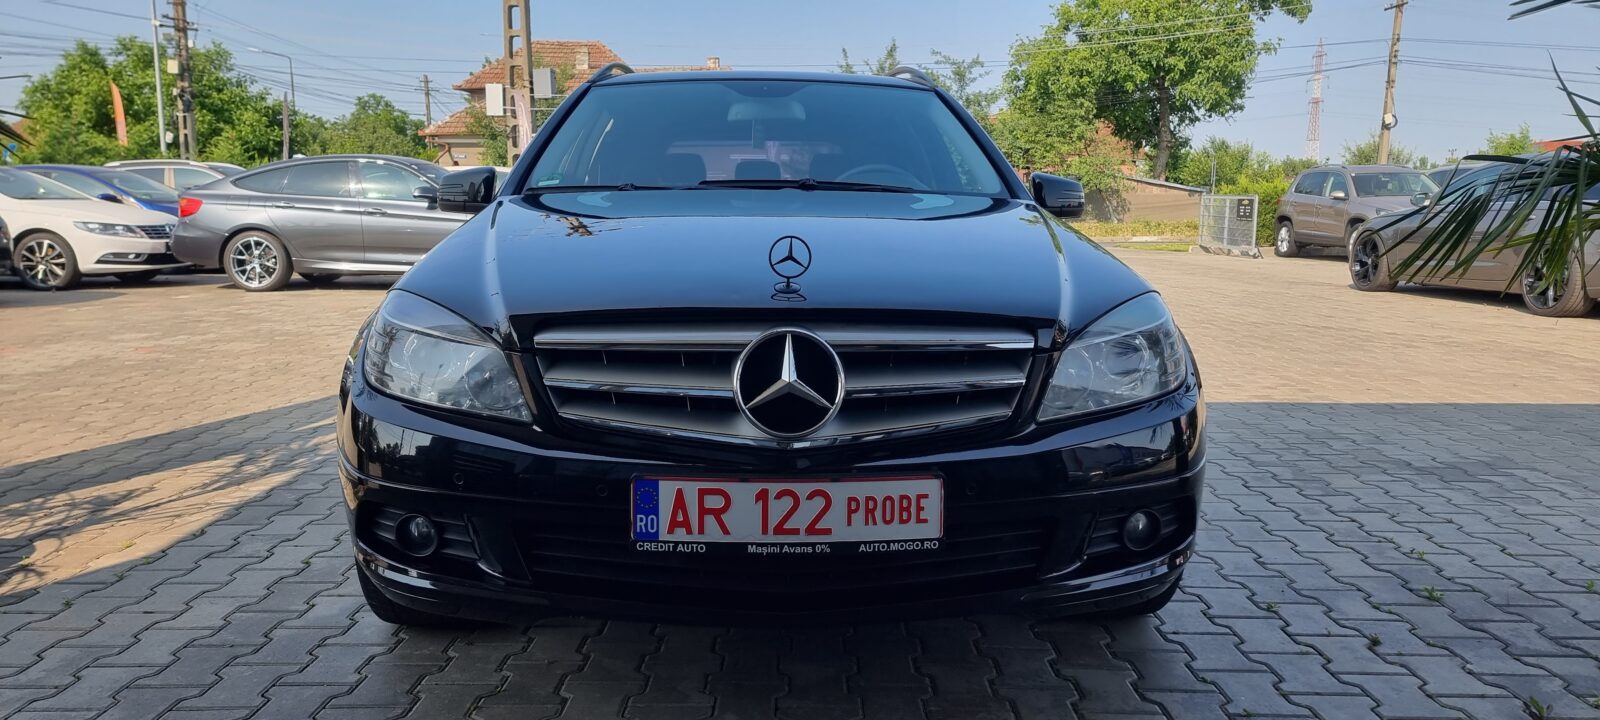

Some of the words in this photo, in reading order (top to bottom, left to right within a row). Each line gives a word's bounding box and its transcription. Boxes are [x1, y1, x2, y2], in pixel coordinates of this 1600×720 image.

[666, 486, 732, 536] AR
[753, 487, 833, 537] 122
[846, 493, 930, 528] PROBE
[636, 514, 657, 533] RO
[636, 542, 675, 552] CREDIT
[677, 543, 706, 553] AUTO
[782, 544, 813, 553] Avans
[815, 544, 831, 553] 0%
[859, 541, 939, 553] AUTO.MOGO.RO
